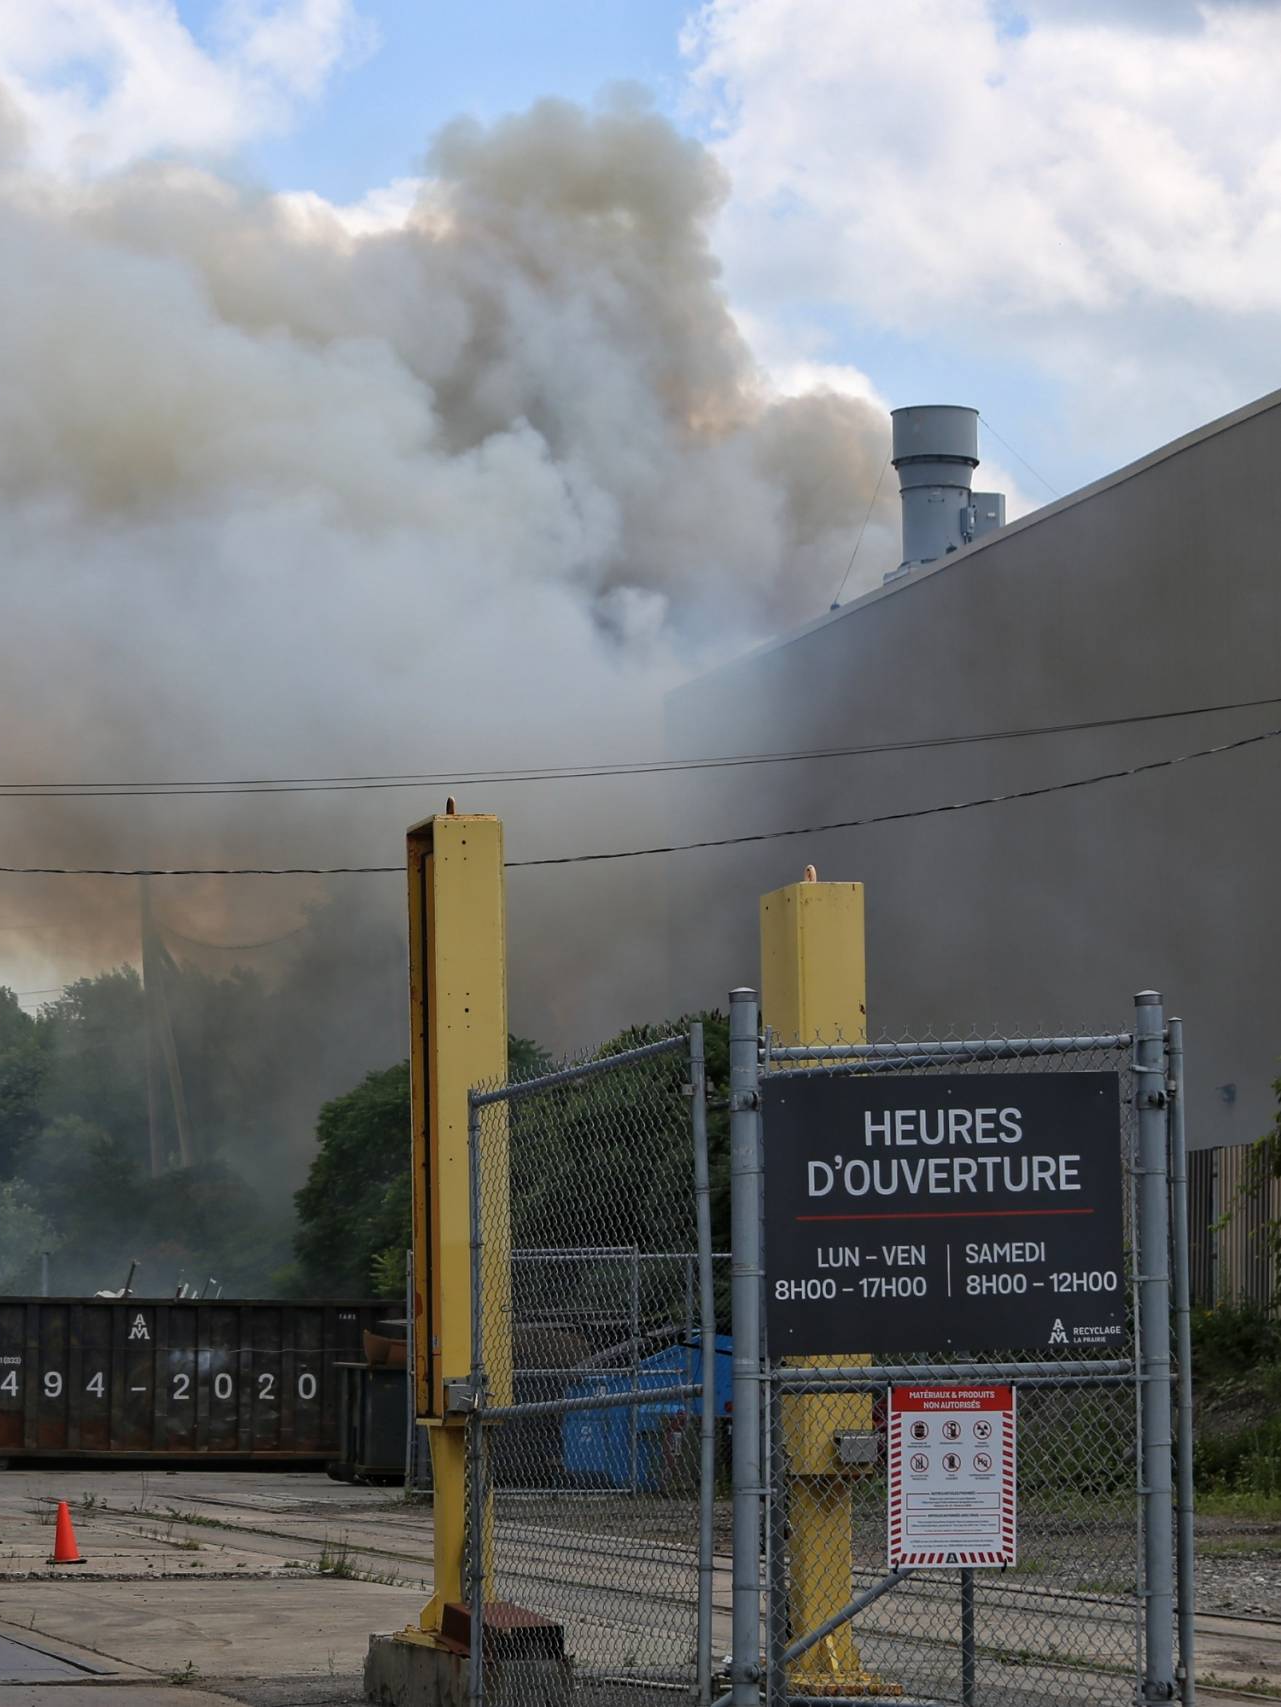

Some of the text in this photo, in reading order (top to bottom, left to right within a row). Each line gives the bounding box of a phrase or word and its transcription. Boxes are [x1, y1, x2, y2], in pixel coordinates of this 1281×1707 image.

[864, 1107, 1023, 1146] HEURES
[817, 1246, 860, 1268] LUN
[881, 1245, 926, 1266] VEN
[965, 1241, 1046, 1264] SAMEDI
[775, 1278, 837, 1300] 8H00
[858, 1276, 927, 1298] 17H00
[966, 1273, 1027, 1295] 8H00
[1049, 1271, 1117, 1292] 12H00
[1073, 1325, 1121, 1335] RECYCLAGE
[909, 1389, 995, 1399] MATÉRIAUX & PRODUITS
[923, 1400, 981, 1409] NON AUTORISÉS
